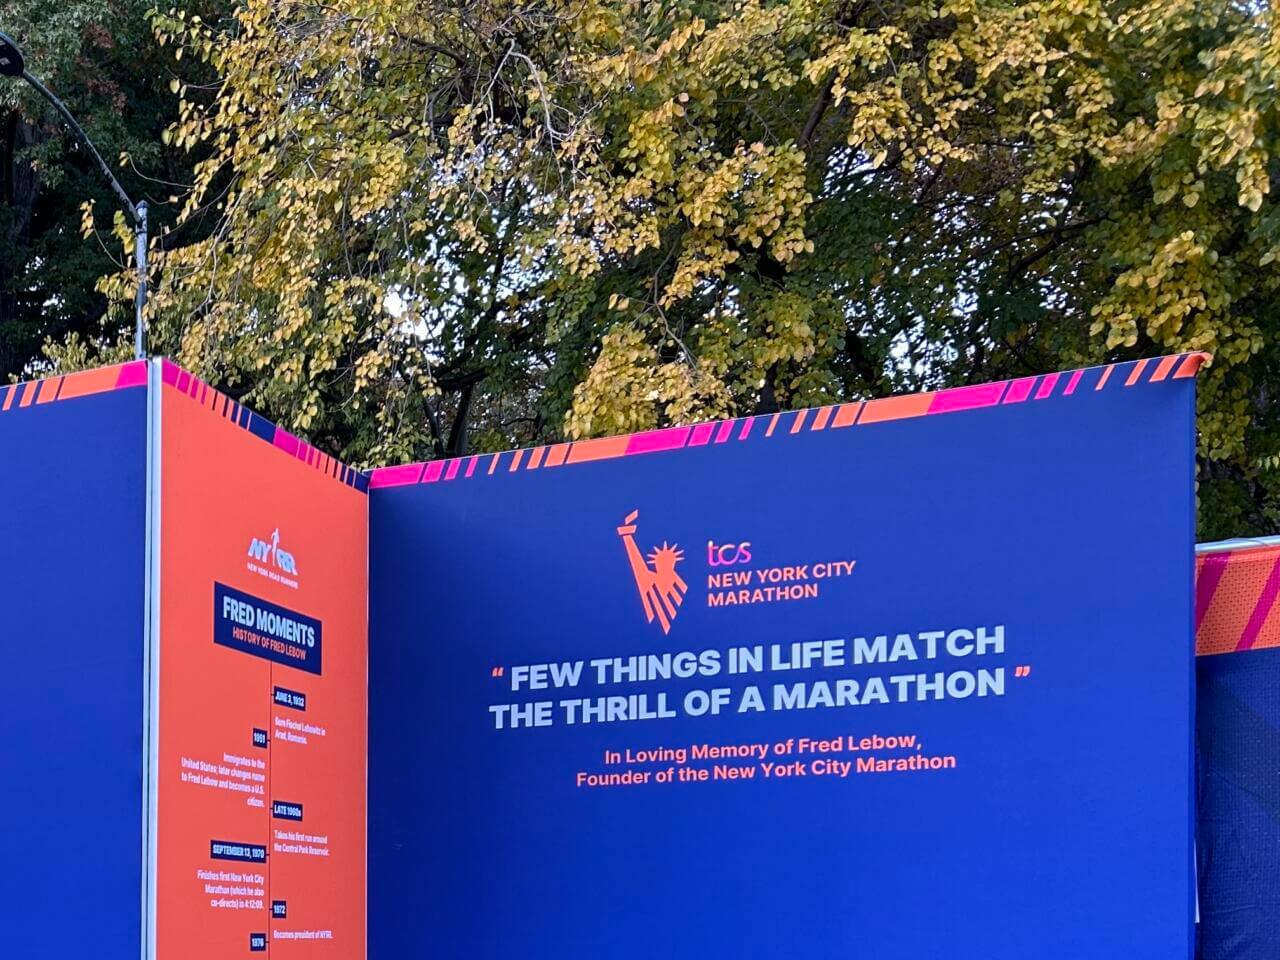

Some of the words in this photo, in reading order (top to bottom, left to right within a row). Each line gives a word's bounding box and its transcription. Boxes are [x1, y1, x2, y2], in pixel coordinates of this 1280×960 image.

[708, 541, 751, 566] tcs
[708, 572, 752, 589] NEW
[756, 565, 809, 582] YORK
[813, 561, 855, 578] CITY
[708, 585, 818, 606] MARATHON
[223, 595, 255, 627] FRED
[256, 608, 315, 648] MOMENTS
[232, 626, 260, 646] HISTORY
[261, 637, 270, 648] OF
[270, 639, 285, 654] FRED
[285, 644, 306, 660] LEBOW
[512, 661, 584, 690] FEW
[591, 650, 720, 684] THINGS
[729, 646, 763, 674] IN
[772, 638, 845, 669] LIFE
[854, 626, 1004, 664] MATCH
[489, 702, 552, 728] THE
[560, 693, 676, 724] THRILL
[684, 688, 730, 716] OF
[738, 686, 765, 712] A
[772, 668, 1005, 711] MARATHON
[606, 751, 620, 763] In
[627, 747, 686, 763] Loving
[692, 741, 768, 761] Memory
[774, 739, 793, 754] of
[799, 737, 842, 753] Fred
[848, 735, 921, 750] Lebow,
[577, 771, 650, 786] Founder
[656, 768, 673, 782] of
[677, 764, 708, 782] the
[714, 766, 755, 779] New
[759, 759, 805, 777] York
[812, 760, 851, 777] City
[854, 751, 956, 773] Marathon
[212, 844, 244, 856] SEPTEMBER
